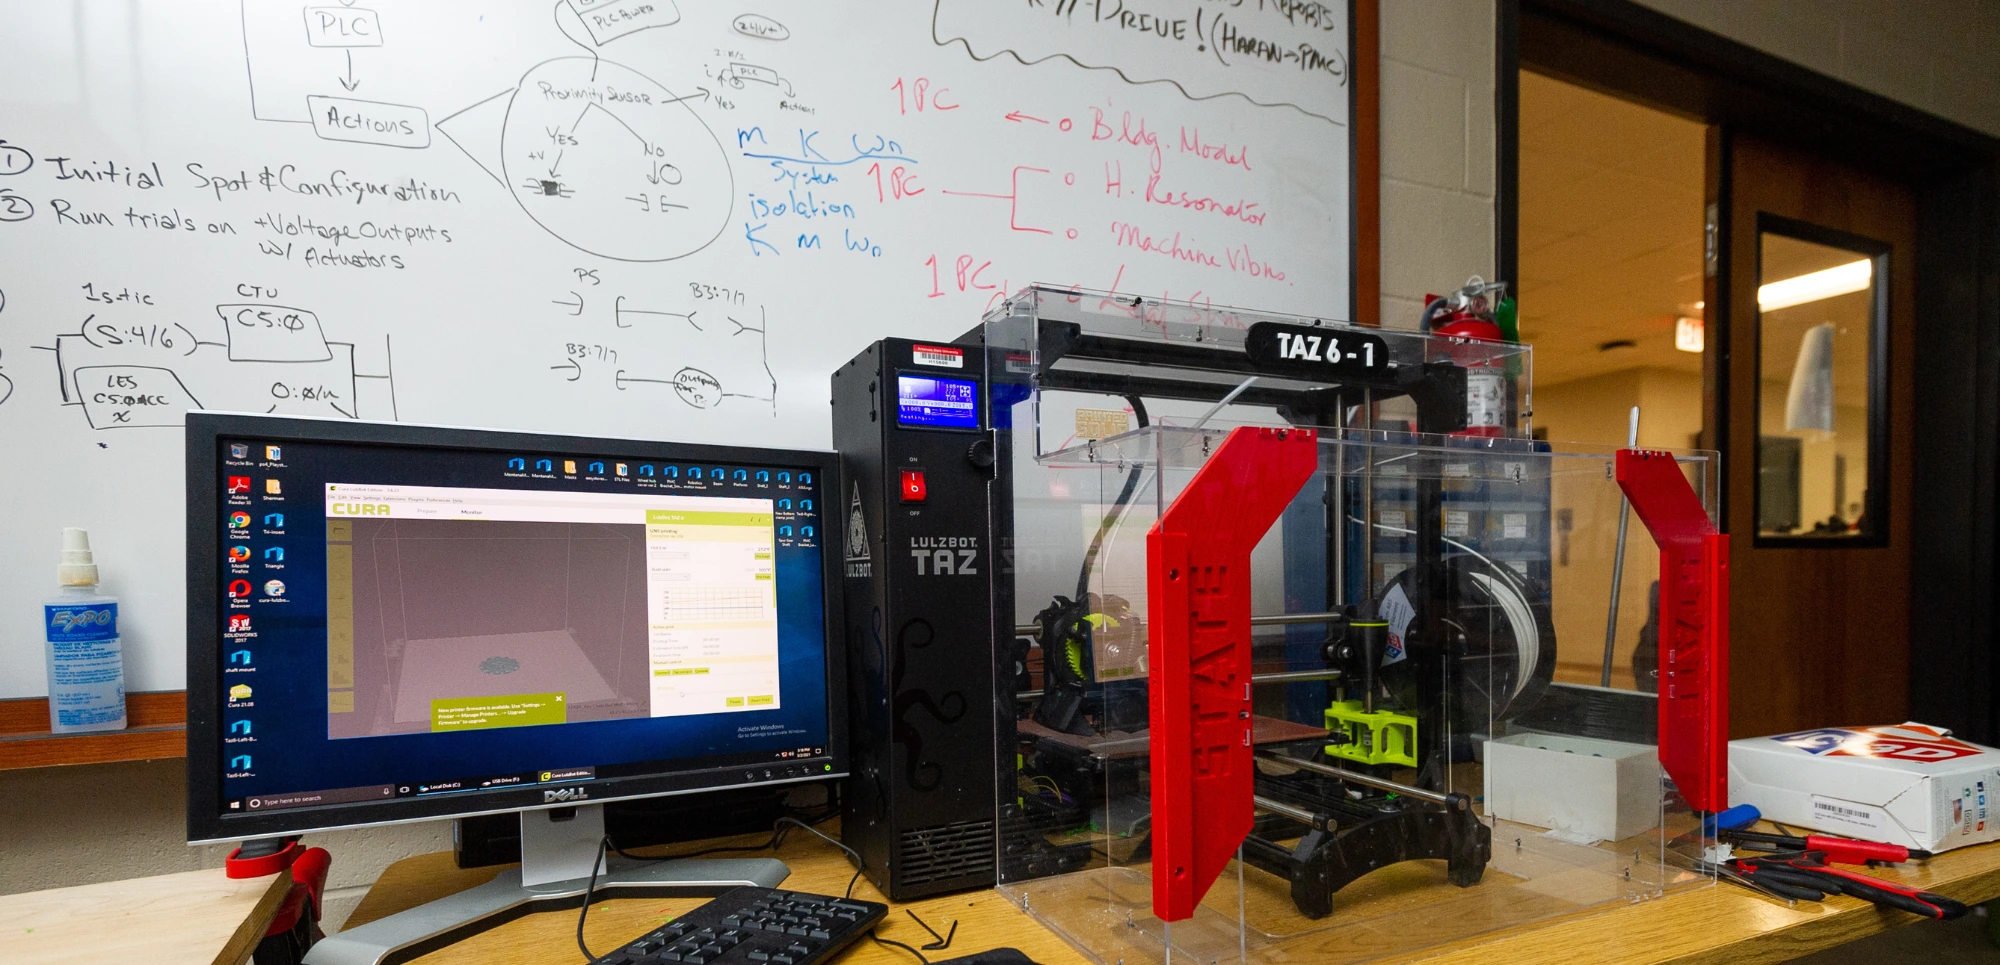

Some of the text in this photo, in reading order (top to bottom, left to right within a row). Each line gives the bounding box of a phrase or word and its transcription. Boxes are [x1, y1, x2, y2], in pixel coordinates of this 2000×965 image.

[315, 11, 370, 39] PLC
[592, 12, 620, 32] PLC
[327, 106, 415, 136] Actions
[1179, 126, 1252, 172] Model
[45, 155, 165, 189] Initial
[187, 163, 253, 202] Spot
[51, 199, 115, 228] Run
[123, 203, 197, 233] trials
[206, 219, 238, 236] on
[359, 221, 454, 244] Outputs
[748, 191, 857, 222] isolation
[236, 283, 280, 299] CTU
[1276, 331, 1323, 363] TAZ
[332, 503, 391, 516] CURA
[911, 550, 977, 576] TAZ
[1188, 564, 1237, 780] STATE
[543, 787, 589, 803] DELL
